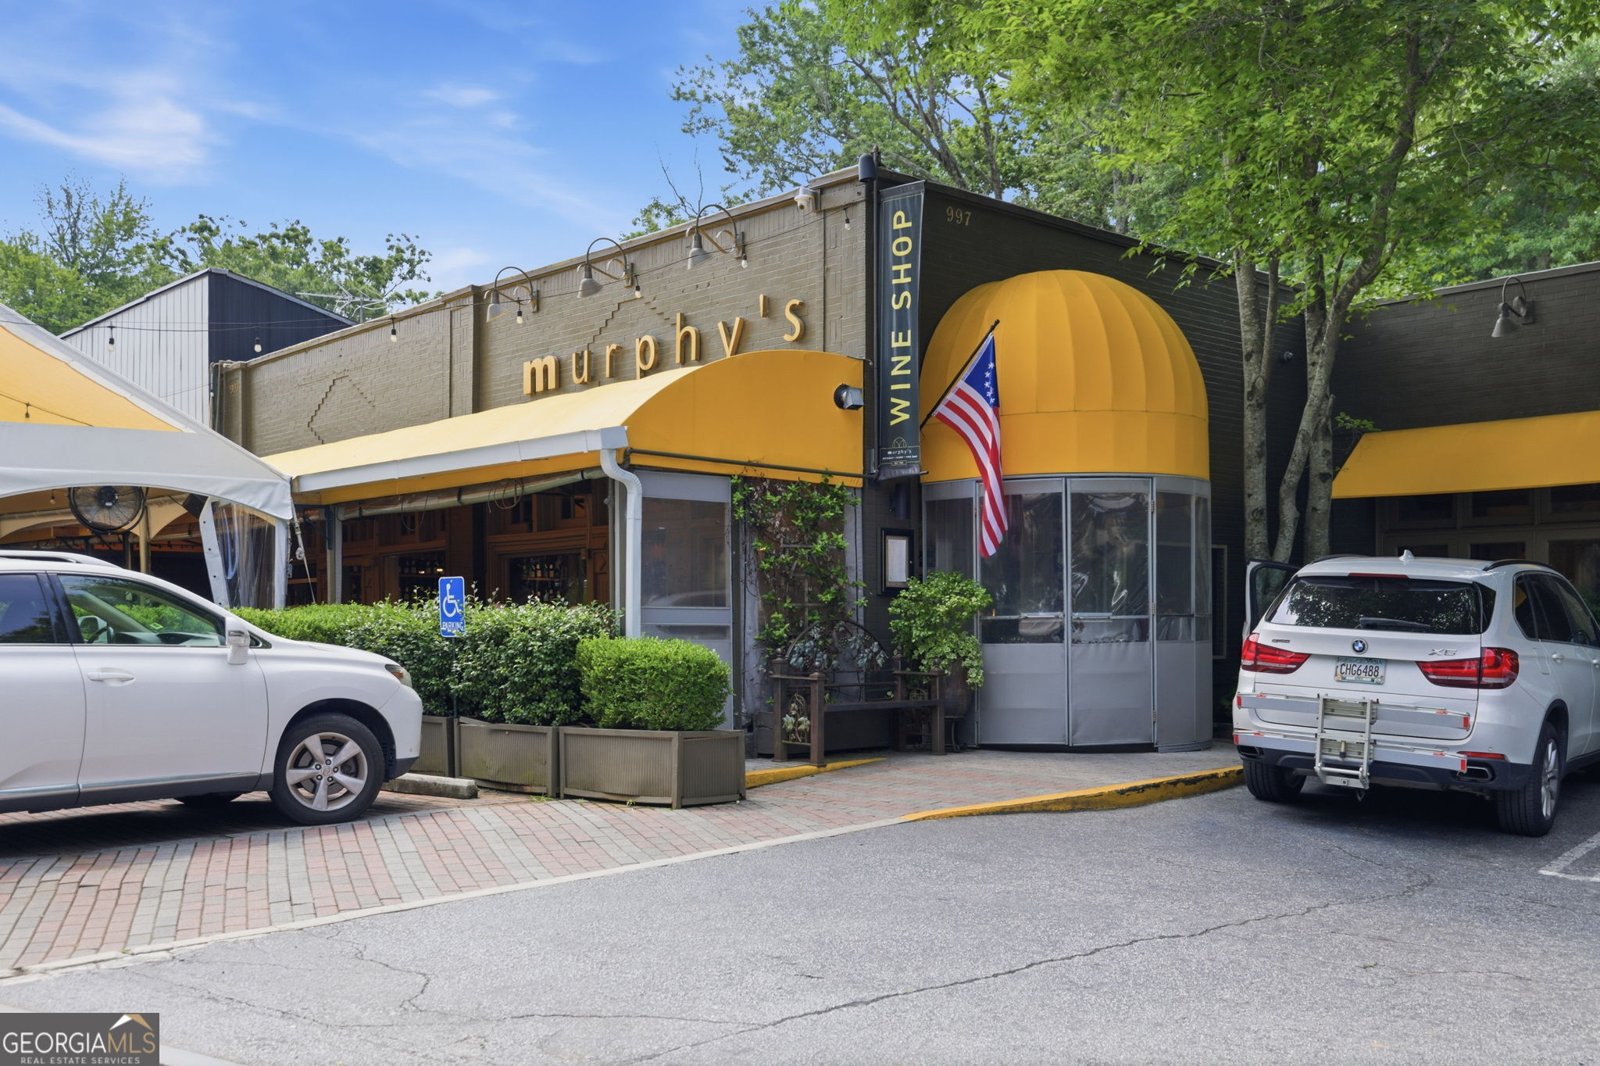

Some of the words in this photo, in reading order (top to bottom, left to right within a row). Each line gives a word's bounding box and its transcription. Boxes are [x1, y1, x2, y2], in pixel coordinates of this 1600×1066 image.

[891, 210, 913, 310] SHOP
[946, 206, 972, 226] 997
[523, 294, 804, 395] murphy's
[889, 329, 912, 426] WINE
[1340, 663, 1380, 678] CHG6488
